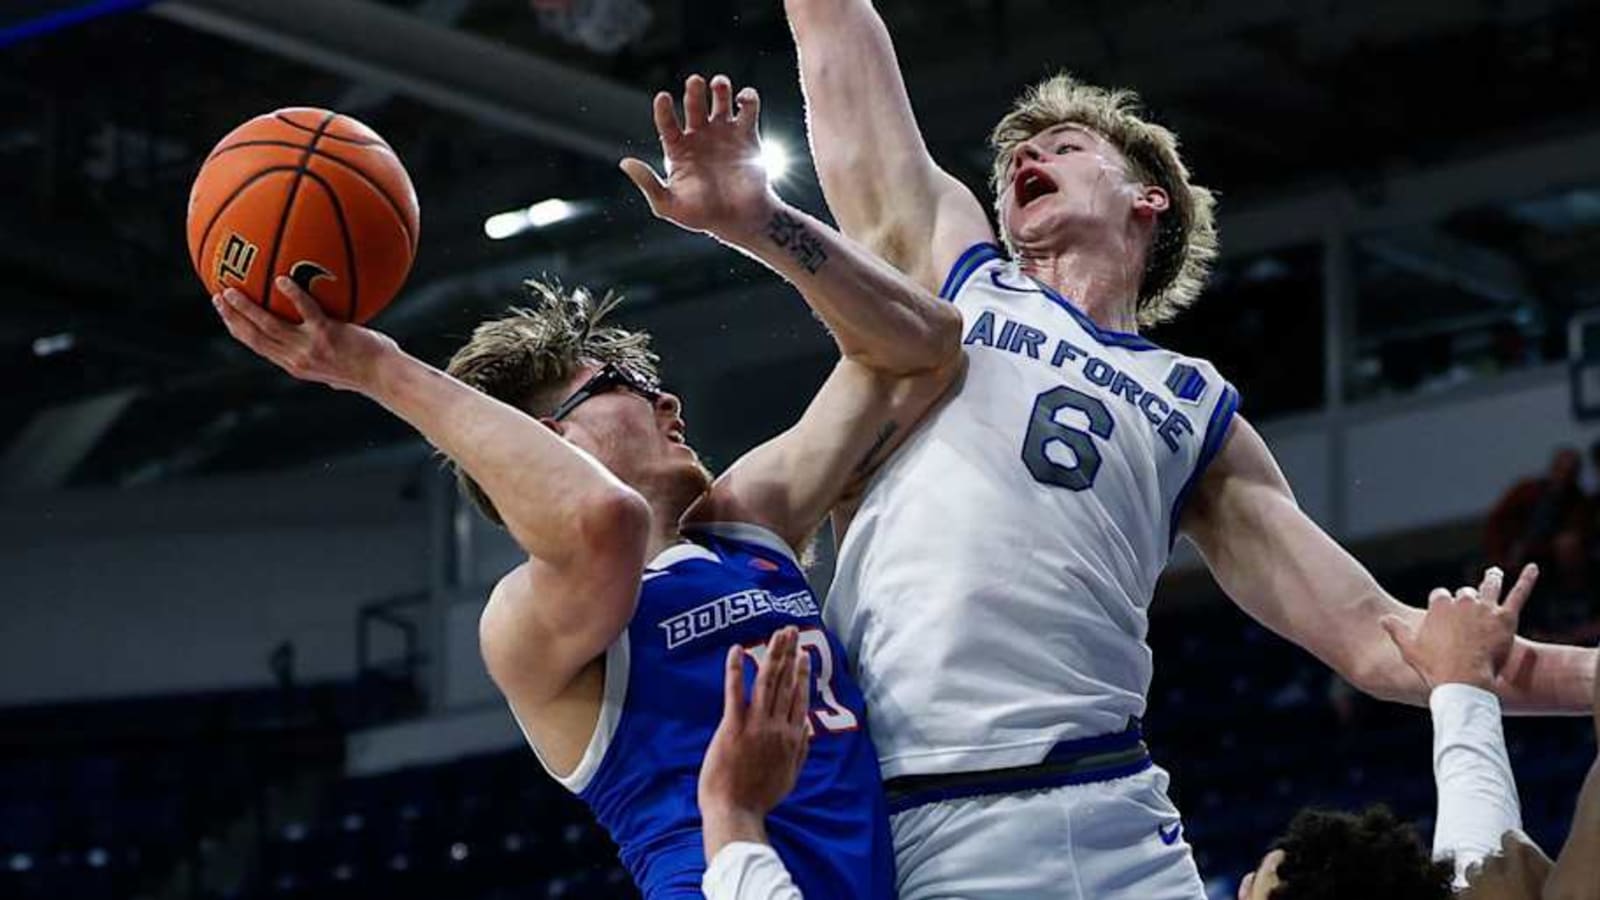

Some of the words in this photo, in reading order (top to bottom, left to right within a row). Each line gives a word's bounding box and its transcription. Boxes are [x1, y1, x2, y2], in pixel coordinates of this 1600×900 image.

[963, 311, 1048, 360] AIR
[1050, 339, 1195, 454] FORCE
[1020, 384, 1117, 492] 6
[657, 589, 771, 650] BOISE
[742, 626, 861, 736] 3
